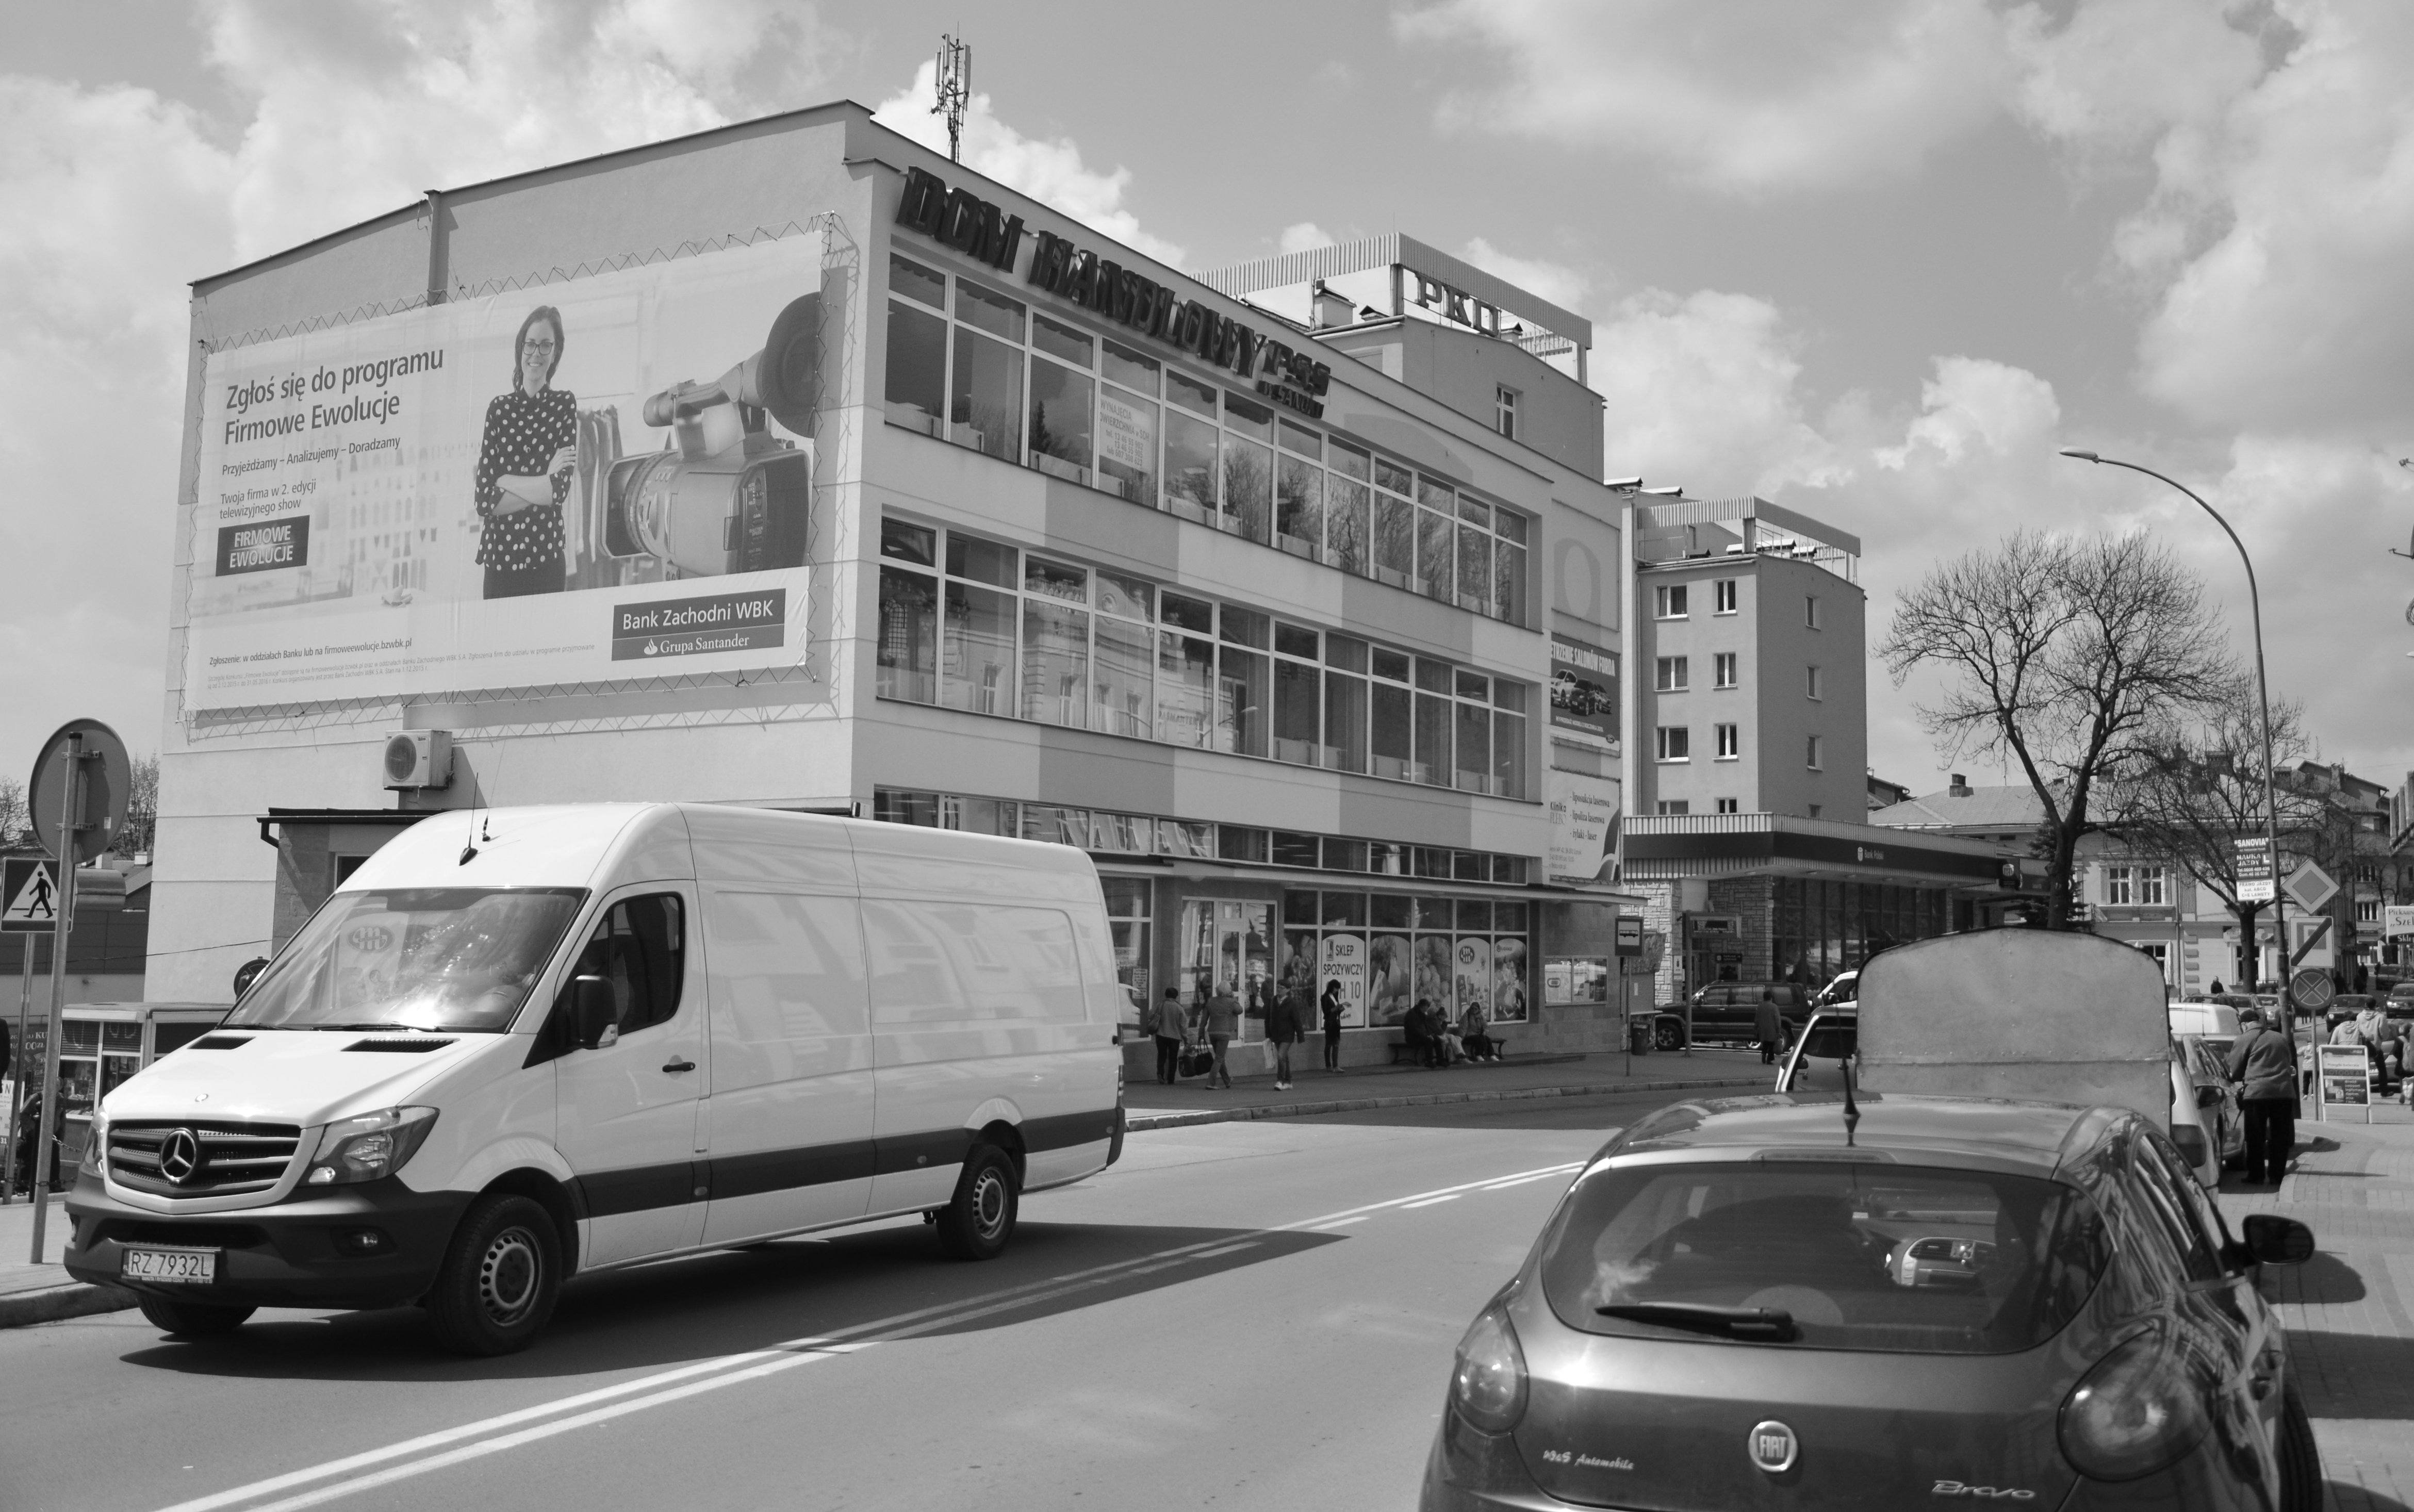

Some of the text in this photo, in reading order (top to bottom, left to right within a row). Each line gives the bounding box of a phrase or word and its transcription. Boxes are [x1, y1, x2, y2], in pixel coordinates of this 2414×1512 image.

[895, 166, 1025, 273] DOM
[1028, 230, 1267, 379] HANDLOWY
[226, 349, 444, 414] Zgłoś się do programu
[225, 390, 400, 445] Firmowe Ewolucje
[222, 437, 400, 475] Przyjeżdżamy Analizujemy Doradzamy
[221, 479, 316, 504] Twoja firma w 2. edycji
[220, 499, 301, 520] telewizyjnego show
[234, 525, 291, 548] FIRMOWE
[229, 545, 293, 568] EWOLUCJE
[623, 599, 774, 630] Bank Zachodni WBK
[210, 654, 241, 667] Zgłoszenie:
[250, 650, 282, 661] oddziałach
[283, 649, 302, 659] Banku
[304, 647, 314, 656] lub
[324, 637, 412, 654] firmoweewolucje.bzwbk.pl
[660, 633, 750, 655] Grupa Santander
[2263, 854, 2270, 863] L
[1336, 945, 1354, 956] SKLEP
[1323, 962, 1364, 975] SPOŻYWCZY
[1350, 981, 1361, 999] 10
[131, 1252, 210, 1277] RZ 7932L
[1760, 1435, 1787, 1458] FIAT
[1932, 1480, 2036, 1499] Bravo
